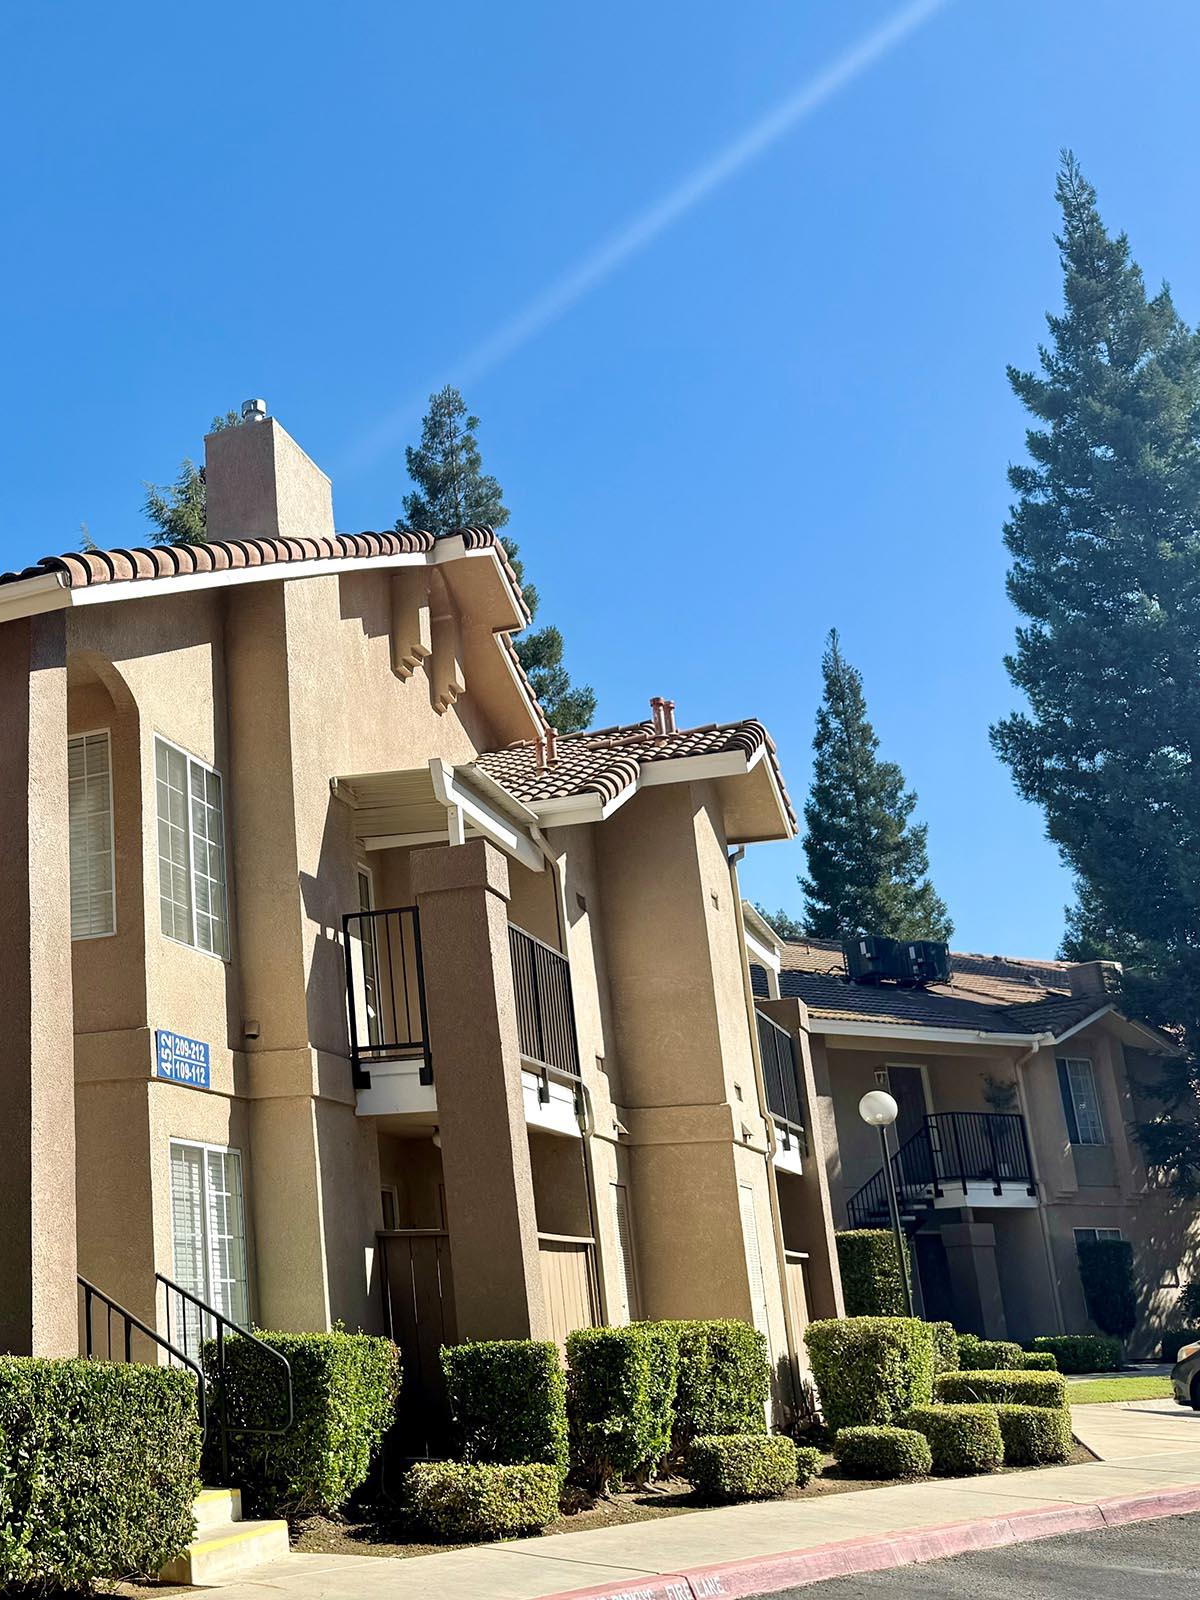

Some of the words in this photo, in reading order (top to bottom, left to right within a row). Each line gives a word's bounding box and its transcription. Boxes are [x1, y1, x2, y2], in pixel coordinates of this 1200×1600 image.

[161, 1033, 172, 1076] 452
[175, 1037, 205, 1062] 209-212
[175, 1061, 205, 1084] 109-112
[663, 1581, 691, 1600] FIRE
[691, 1575, 725, 1598] LANE
